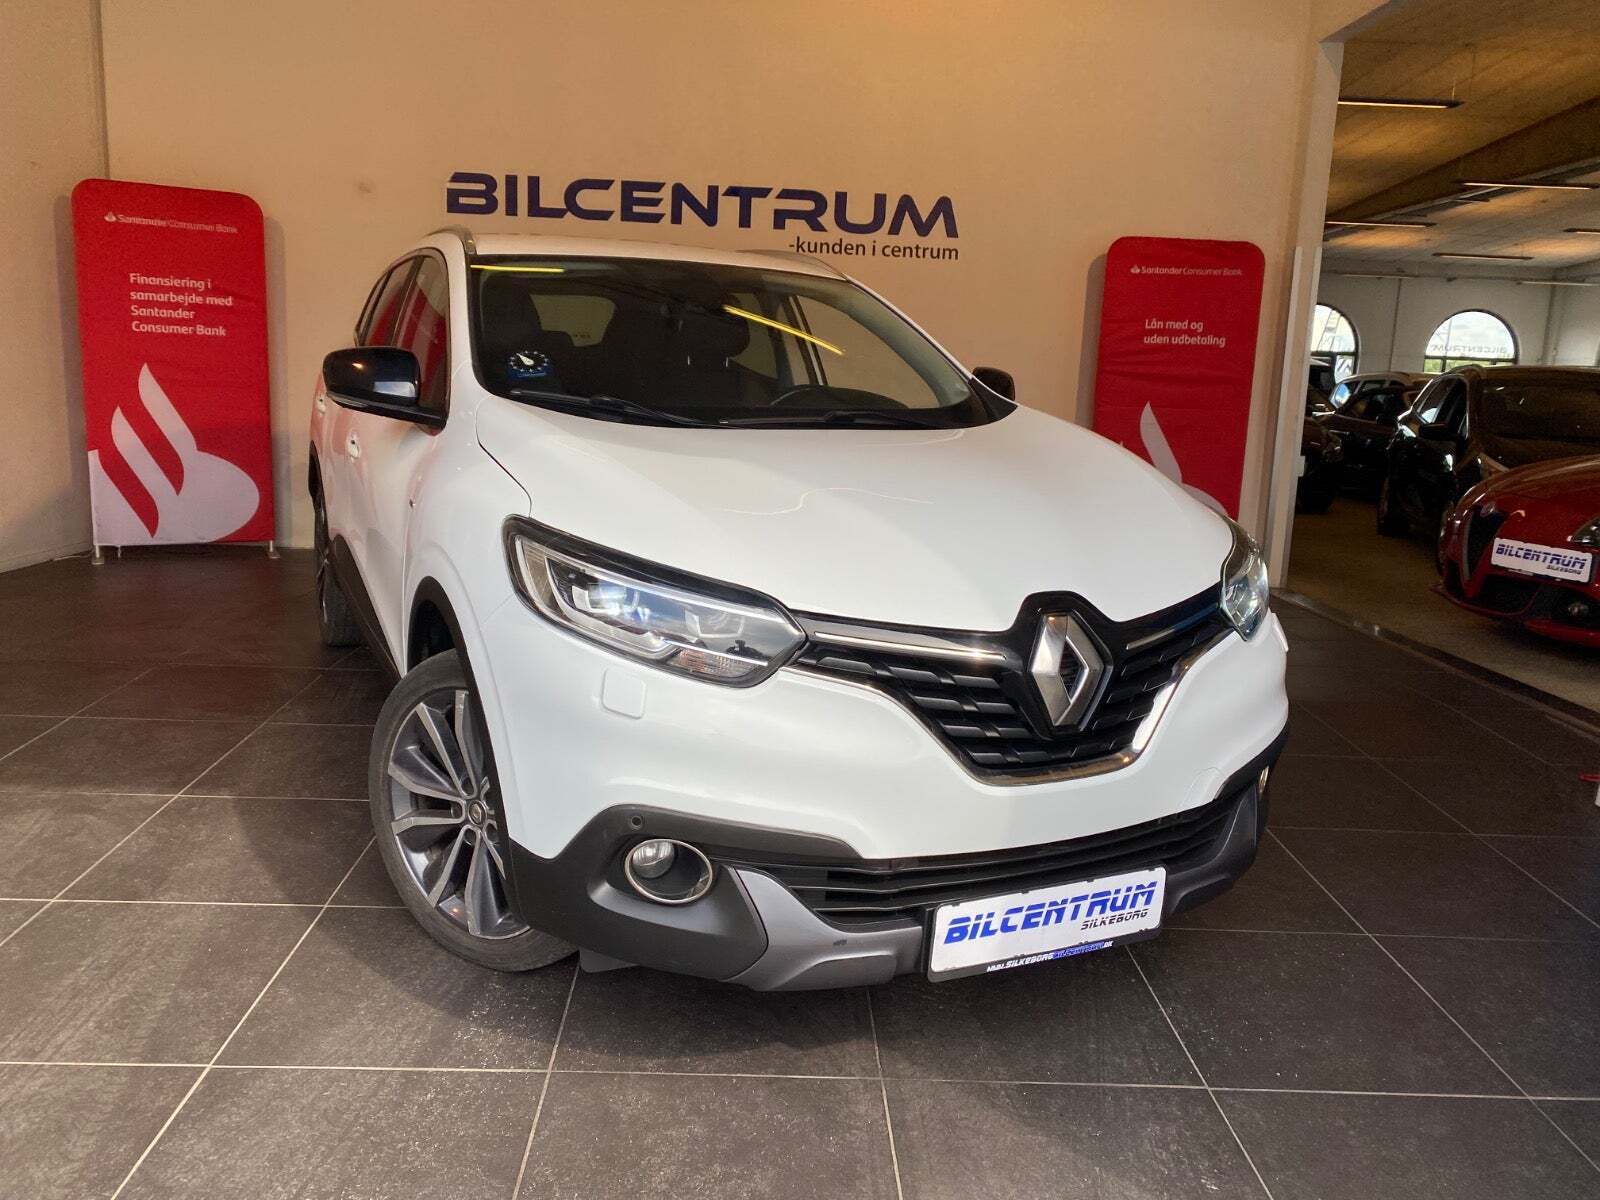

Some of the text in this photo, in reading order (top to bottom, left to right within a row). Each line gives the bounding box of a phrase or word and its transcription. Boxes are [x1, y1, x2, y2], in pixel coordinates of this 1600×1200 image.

[446, 171, 959, 239] BILCENTRUM
[788, 236, 959, 260] -kunden i centrum
[1141, 266, 1182, 275] Santander
[129, 273, 205, 291] Finansiering
[130, 291, 234, 306] samarbejde med
[131, 305, 196, 319] Santander
[132, 321, 227, 337] Consumer Bank
[1145, 319, 1204, 332] Lån med og
[1143, 335, 1227, 348] uden udbetaling
[1495, 543, 1587, 570] BILCENTRUM
[943, 880, 1158, 945] BILCENTRUM
[1080, 908, 1149, 931] SILKEBORG
